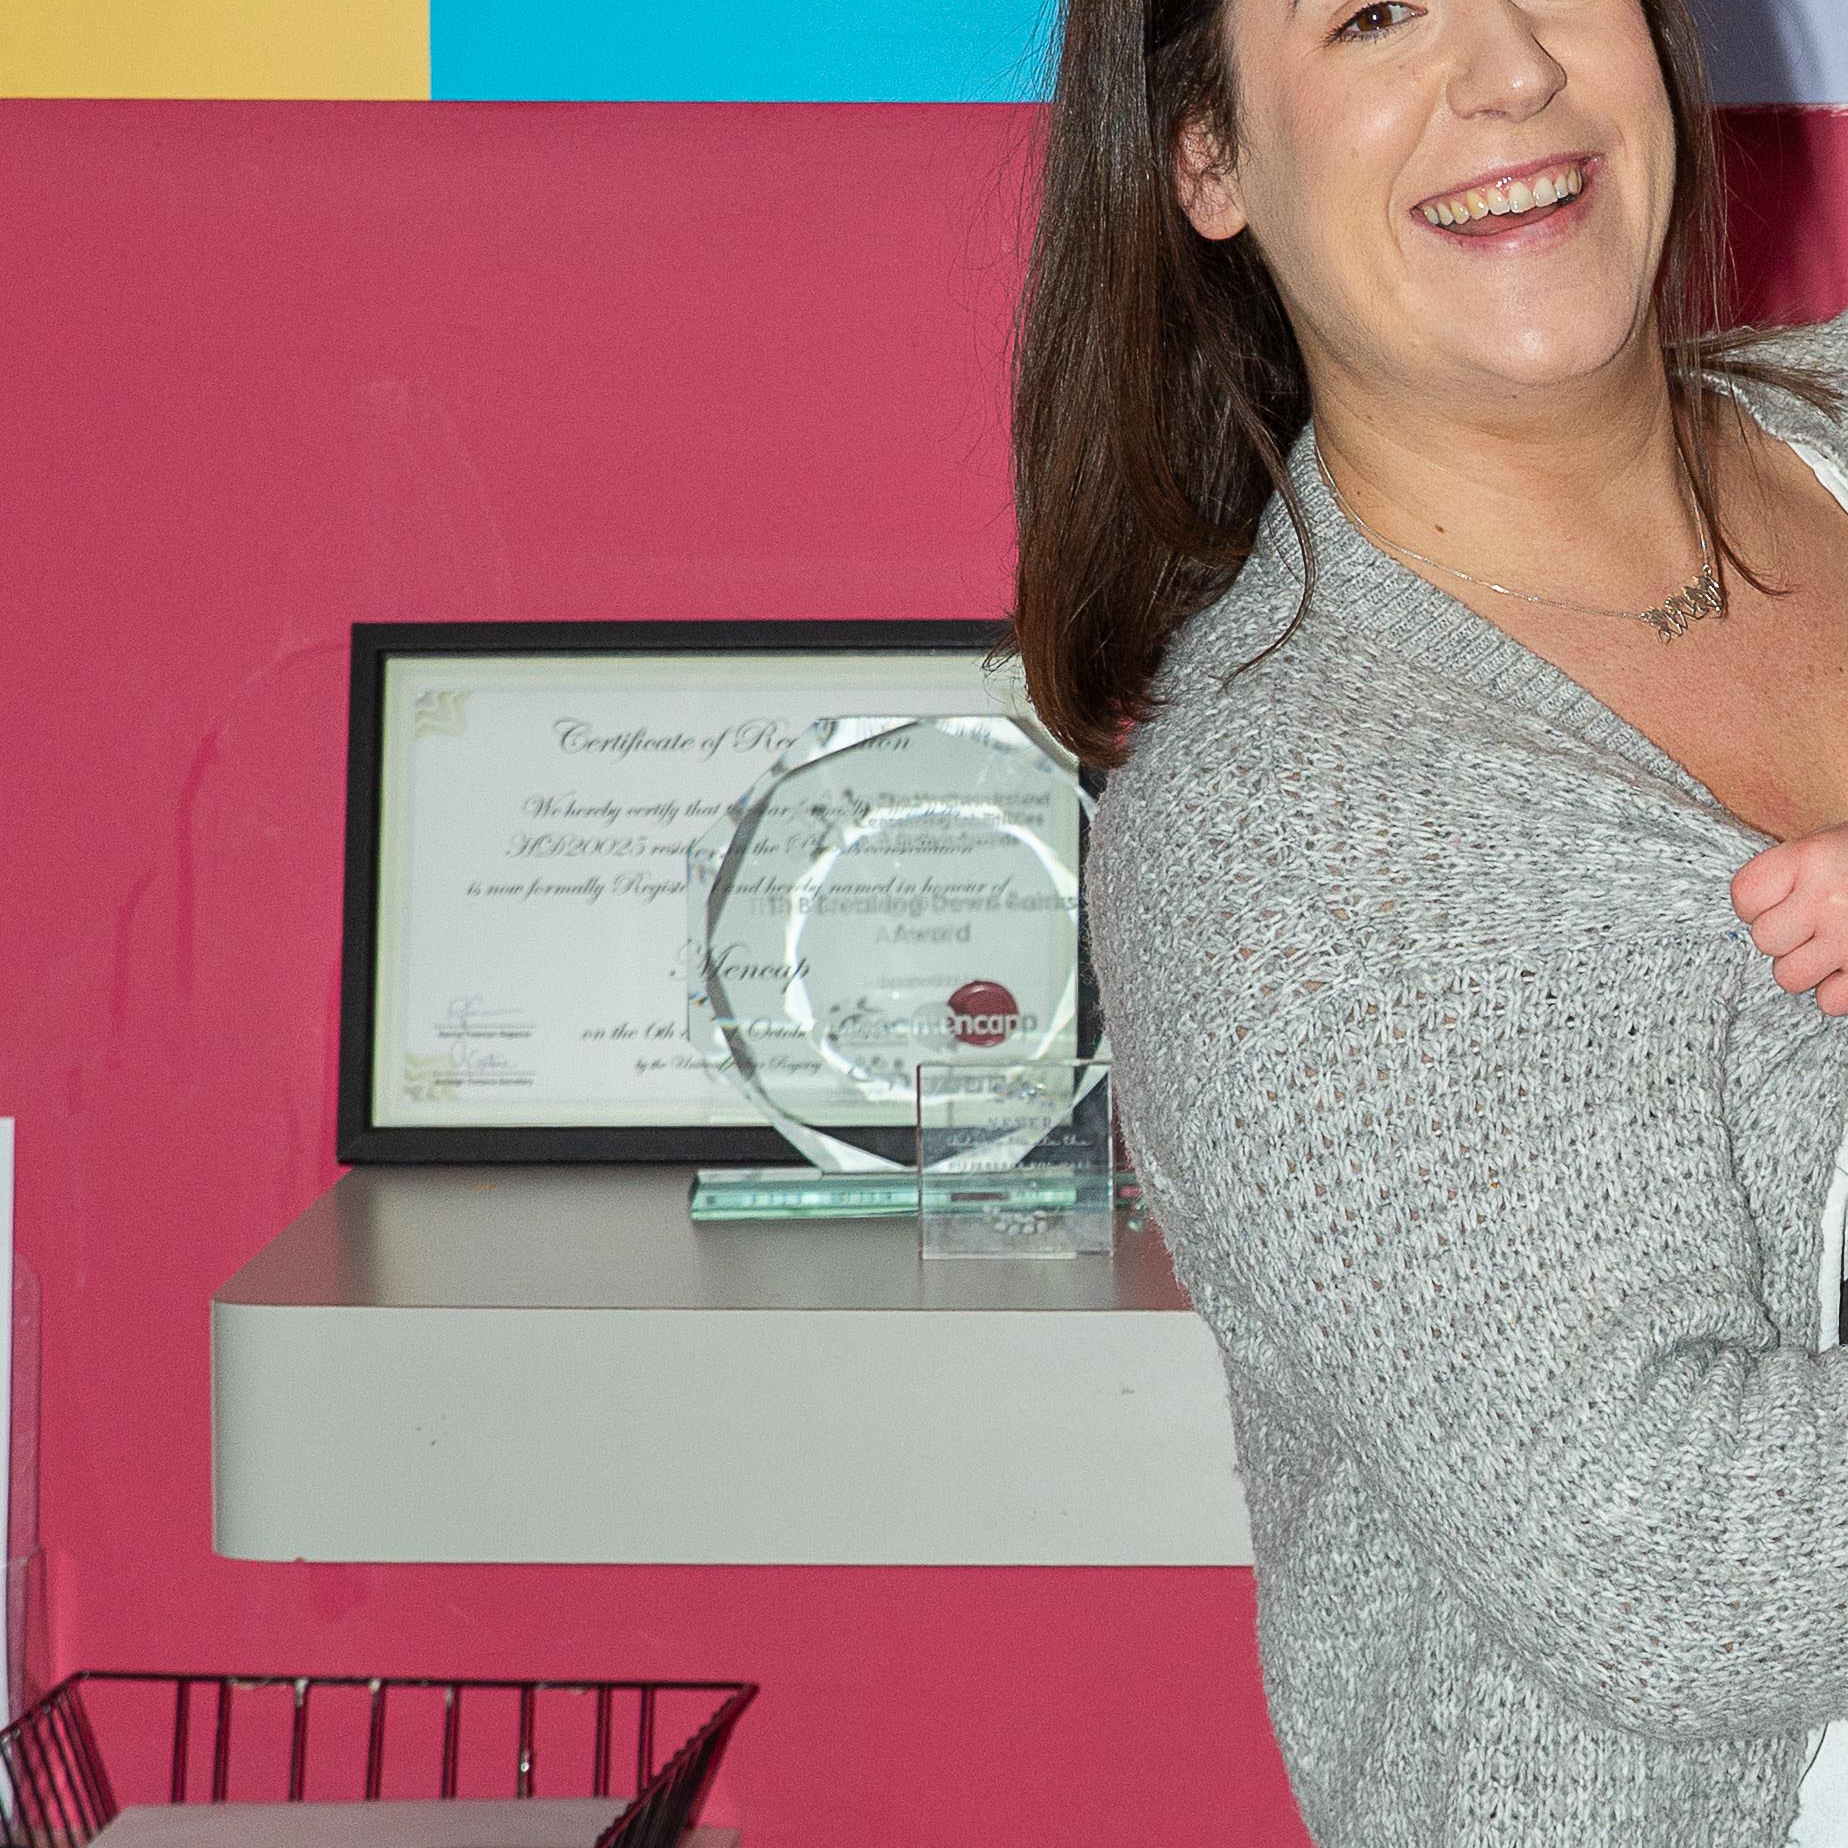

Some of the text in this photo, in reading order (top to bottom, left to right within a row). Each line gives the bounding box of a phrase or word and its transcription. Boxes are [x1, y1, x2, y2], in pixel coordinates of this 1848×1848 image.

[552, 717, 697, 764] Certificate
[700, 726, 736, 764] of
[523, 794, 560, 820] We
[565, 798, 622, 827] hereby
[626, 801, 680, 827] certify
[684, 799, 719, 816] that
[753, 838, 781, 854] the
[467, 881, 483, 896] is
[486, 885, 524, 896] now
[522, 878, 605, 904] formally
[763, 876, 827, 901] hereby
[828, 876, 897, 895] named
[897, 879, 917, 894] in
[921, 875, 988, 895] honour
[991, 874, 1014, 899] of
[669, 939, 811, 992] Mencap
[582, 1028, 606, 1041] on
[610, 1021, 637, 1041] the
